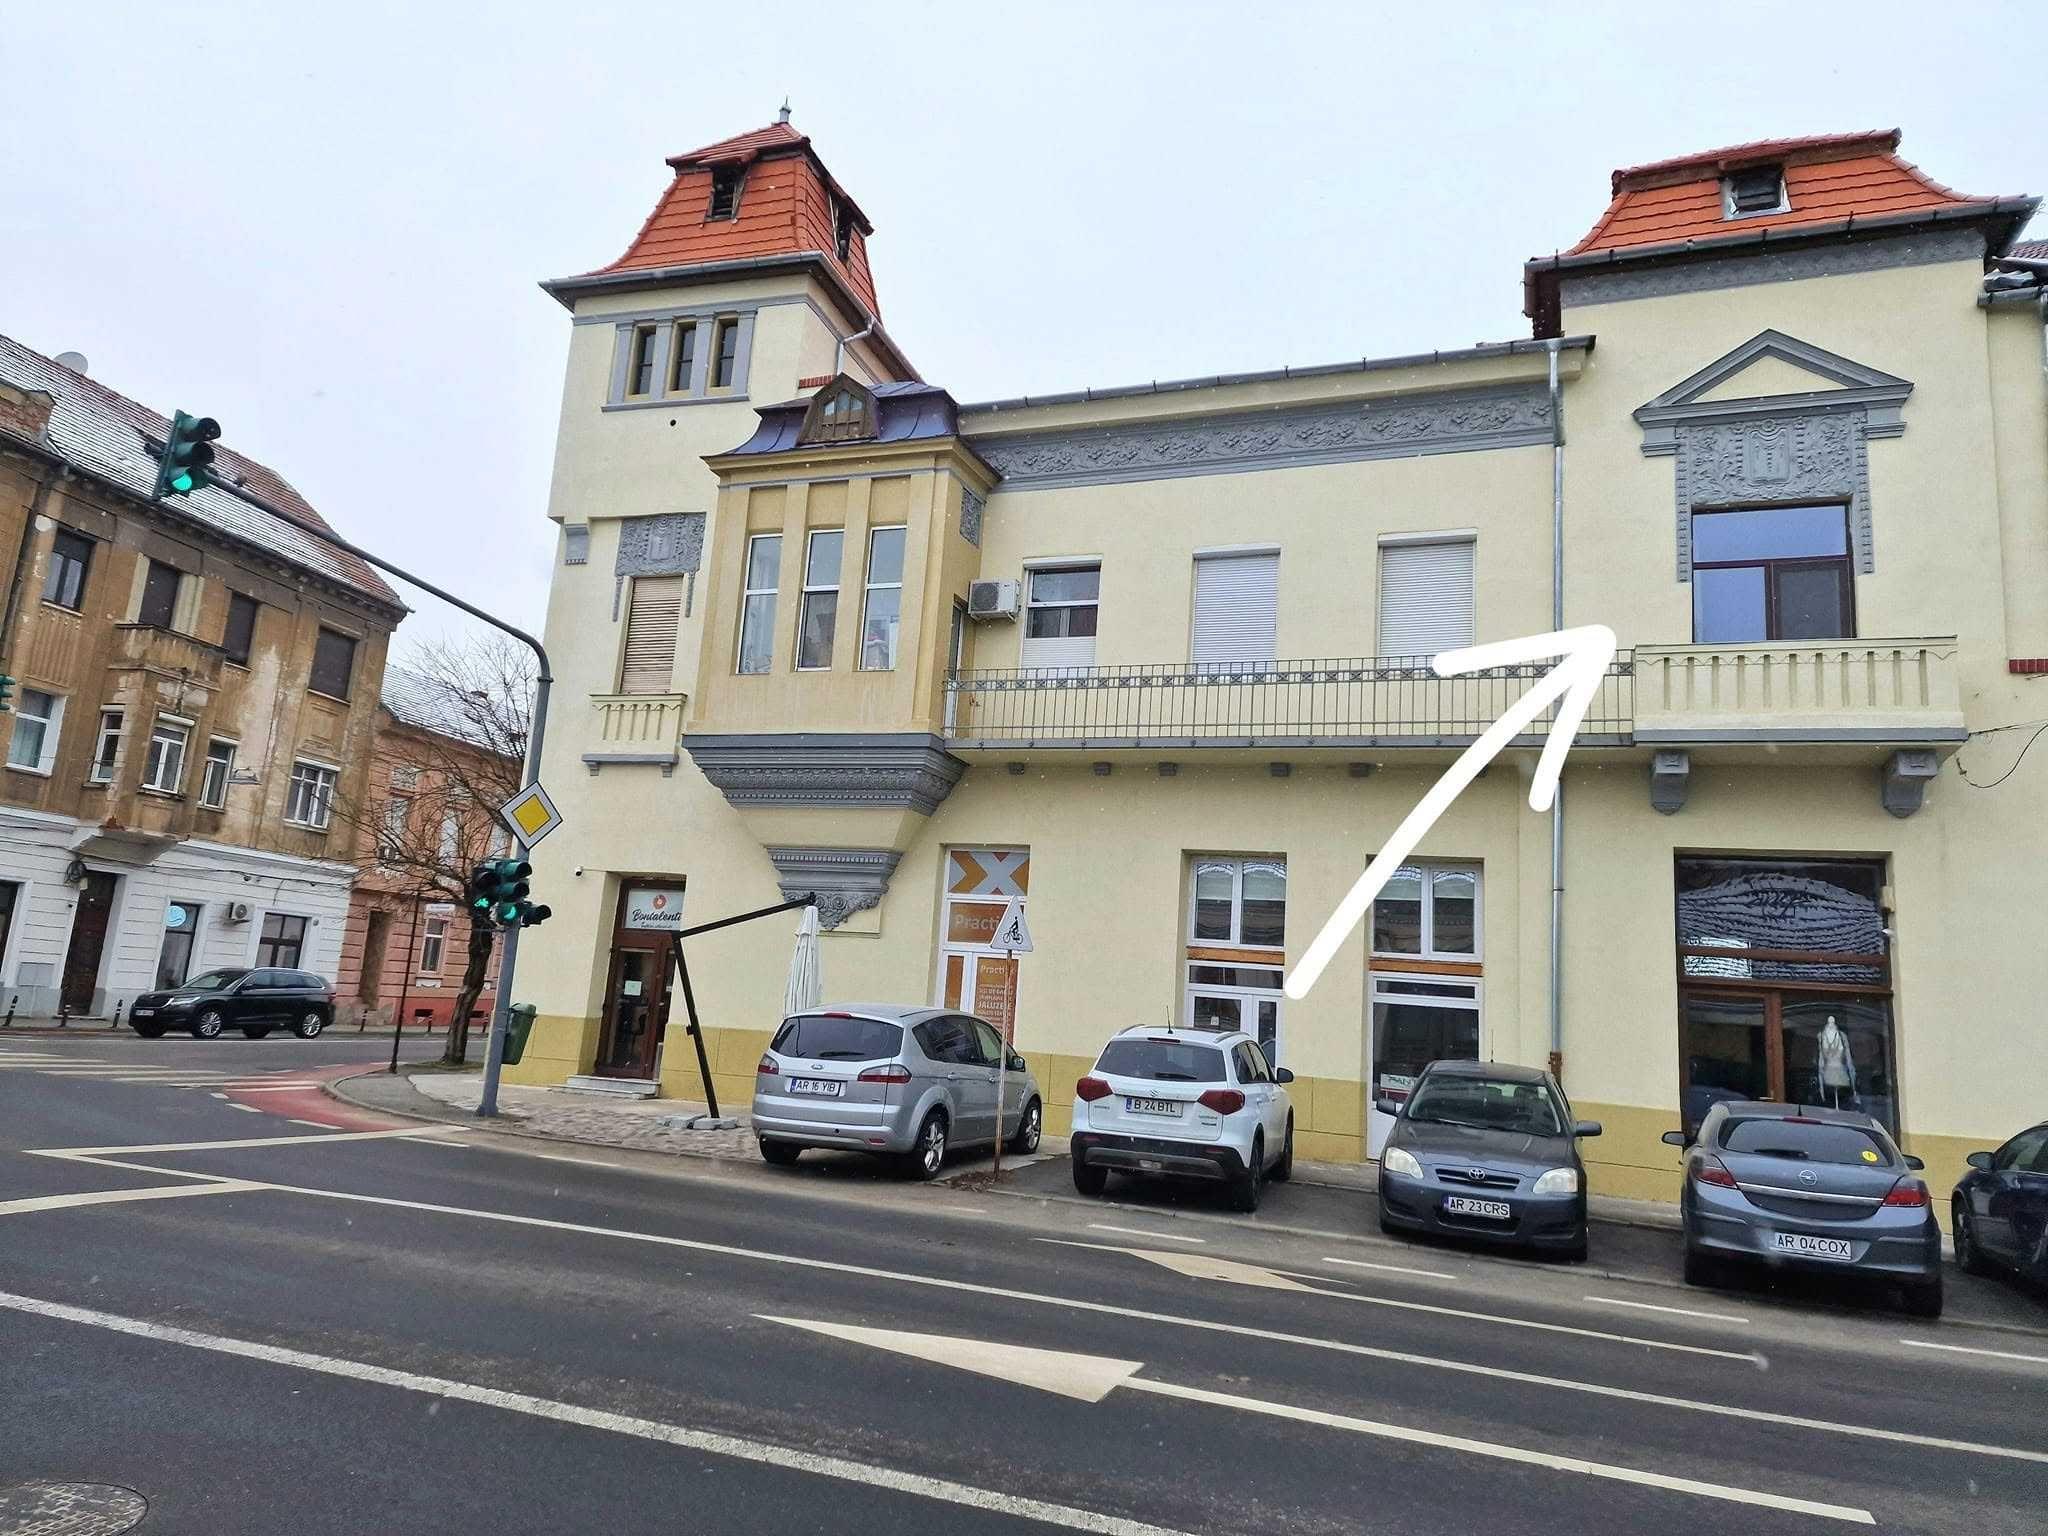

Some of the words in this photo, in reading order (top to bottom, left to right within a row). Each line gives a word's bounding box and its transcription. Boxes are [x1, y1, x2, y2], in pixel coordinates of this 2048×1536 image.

[955, 914, 1001, 930] Practi
[796, 1080, 809, 1090] AR
[1134, 1100, 1142, 1109] B
[1144, 1101, 1156, 1111] 24
[1157, 1102, 1176, 1113] BTL
[1450, 1198, 1465, 1210] AR
[1778, 1235, 1794, 1248] AR
